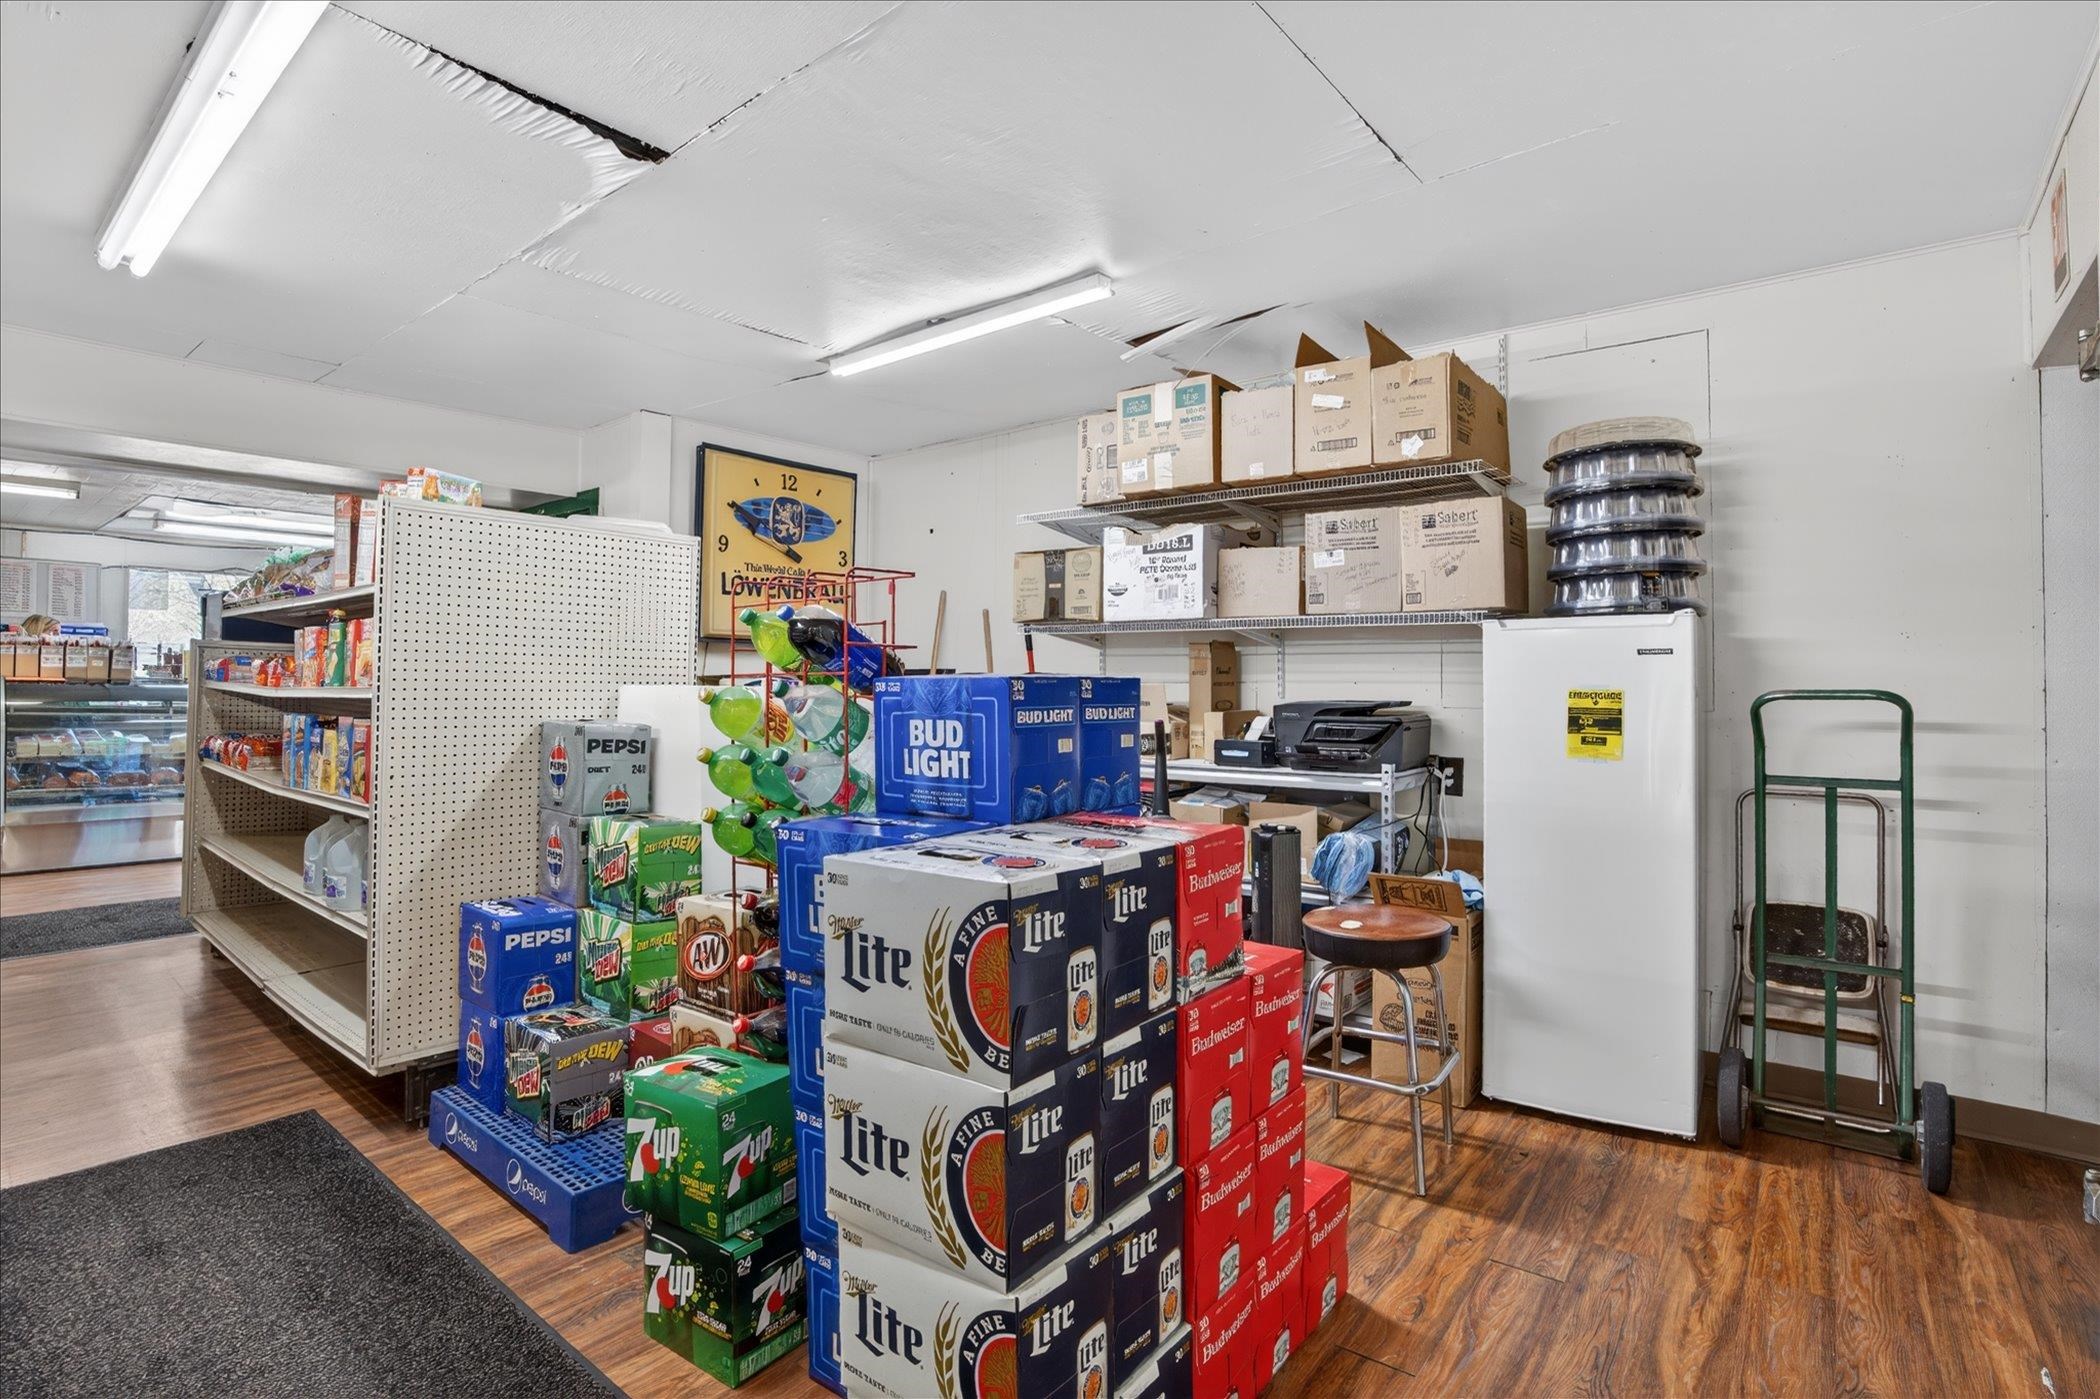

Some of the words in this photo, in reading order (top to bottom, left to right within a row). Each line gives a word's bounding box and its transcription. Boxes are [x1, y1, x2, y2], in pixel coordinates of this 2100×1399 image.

[781, 473, 798, 492] 12
[1438, 510, 1477, 524] Sabert
[718, 535, 729, 552] 9
[838, 551, 848, 567] 3
[1011, 680, 1025, 691] 30
[1080, 679, 1092, 690] 30
[1016, 709, 1042, 724] BUD
[1043, 708, 1074, 723] LIGHT
[1085, 708, 1107, 720] BUD
[1108, 707, 1135, 720] LIGHT
[587, 739, 646, 754] PEPSI
[909, 719, 964, 748] BUD
[632, 764, 643, 775] 24
[903, 748, 971, 779] LIGHT
[671, 835, 700, 855] DEW
[827, 872, 837, 884] 30
[1189, 862, 1242, 893] Budweiser
[1113, 885, 1148, 923] Lite
[505, 927, 572, 951] PEPSI
[958, 905, 998, 947] FINE
[1023, 911, 1065, 953] Lite
[1151, 928, 1170, 957] Lite
[555, 952, 567, 964] 24
[595, 950, 620, 979] DEW
[841, 931, 912, 992] Lite
[954, 953, 965, 967] A
[1071, 960, 1095, 991] Lite
[849, 1015, 872, 1029] TASTE
[590, 1039, 624, 1061] DEW
[1192, 1018, 1245, 1056] Budweiser
[1112, 1058, 1147, 1101] Lite
[1152, 1097, 1171, 1127] Lite
[458, 1130, 477, 1152] pepsi
[956, 1111, 995, 1149] FINE
[1019, 1105, 1063, 1154] Lite
[840, 1109, 910, 1178] Lite
[951, 1152, 963, 1167] A
[1068, 1146, 1093, 1182] Lite
[522, 1179, 547, 1205] pepsi
[848, 1195, 871, 1212] TASTE
[1122, 1227, 1157, 1275] Lite
[1161, 1259, 1179, 1293] Lite
[855, 1293, 924, 1366] Lite
[967, 1315, 1006, 1347] FINE
[1030, 1300, 1075, 1357] Lite
[963, 1350, 974, 1366] A
[1080, 1333, 1104, 1374] Lite
[863, 1373, 886, 1393] TASTE
